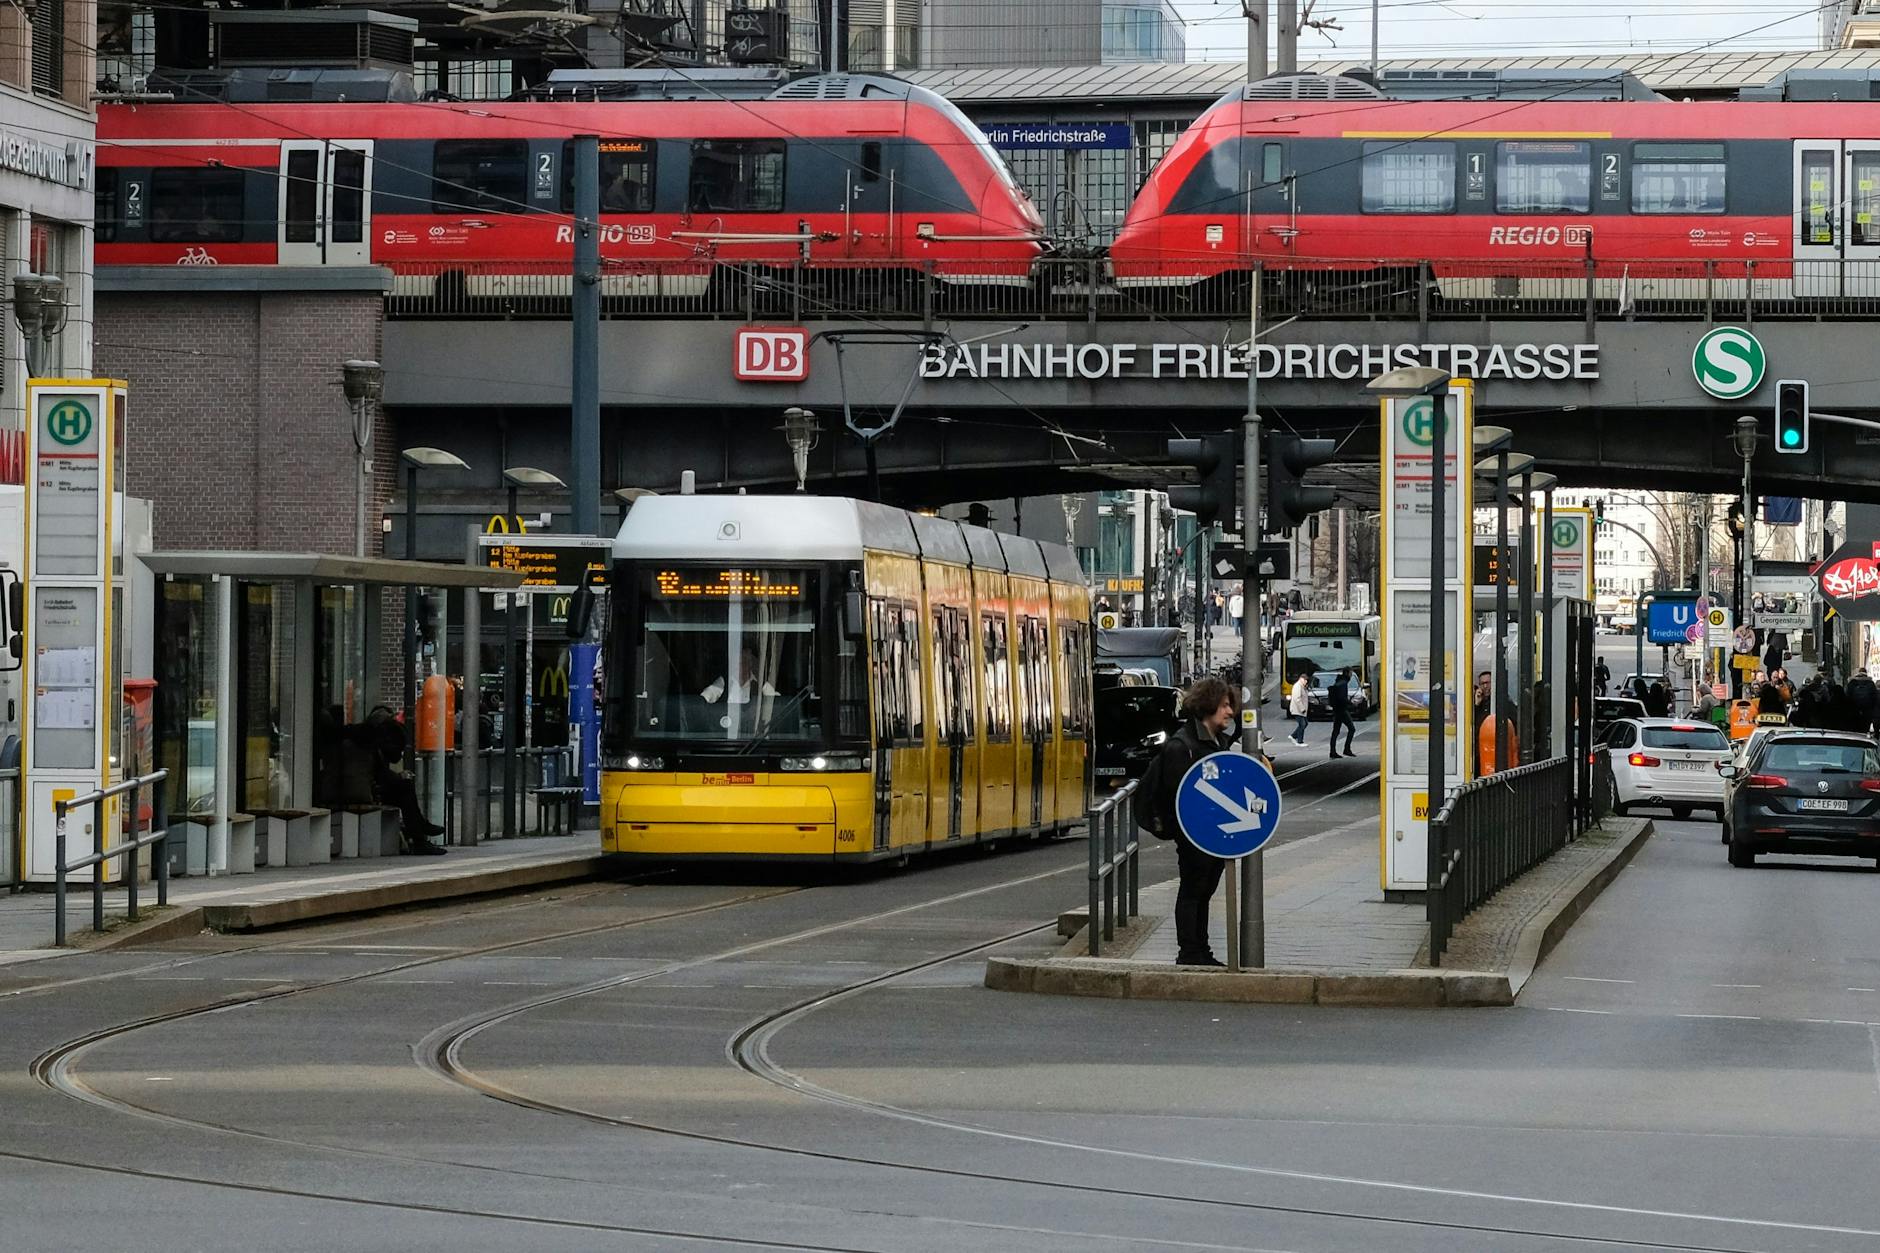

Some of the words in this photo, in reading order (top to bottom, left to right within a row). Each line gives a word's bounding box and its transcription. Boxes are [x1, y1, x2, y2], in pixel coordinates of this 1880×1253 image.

[1012, 130, 1106, 143] Friedrichstraße
[540, 154, 550, 172] 2
[1471, 156, 1480, 172] 1
[1606, 156, 1616, 173] 2
[129, 184, 140, 200] 2
[632, 226, 653, 240] DB
[1489, 227, 1560, 244] REGIO
[746, 337, 798, 372] DB
[919, 344, 1136, 378] BAHNHOF
[1152, 344, 1600, 379] FRIEDRICHSTRASSE
[1704, 332, 1752, 394] S
[59, 410, 80, 436] H
[1558, 526, 1570, 542] H
[1673, 606, 1688, 624] U
[1760, 617, 1806, 627] Georgenstraße
[1416, 807, 1429, 817] BV
[838, 830, 855, 842] 4006
